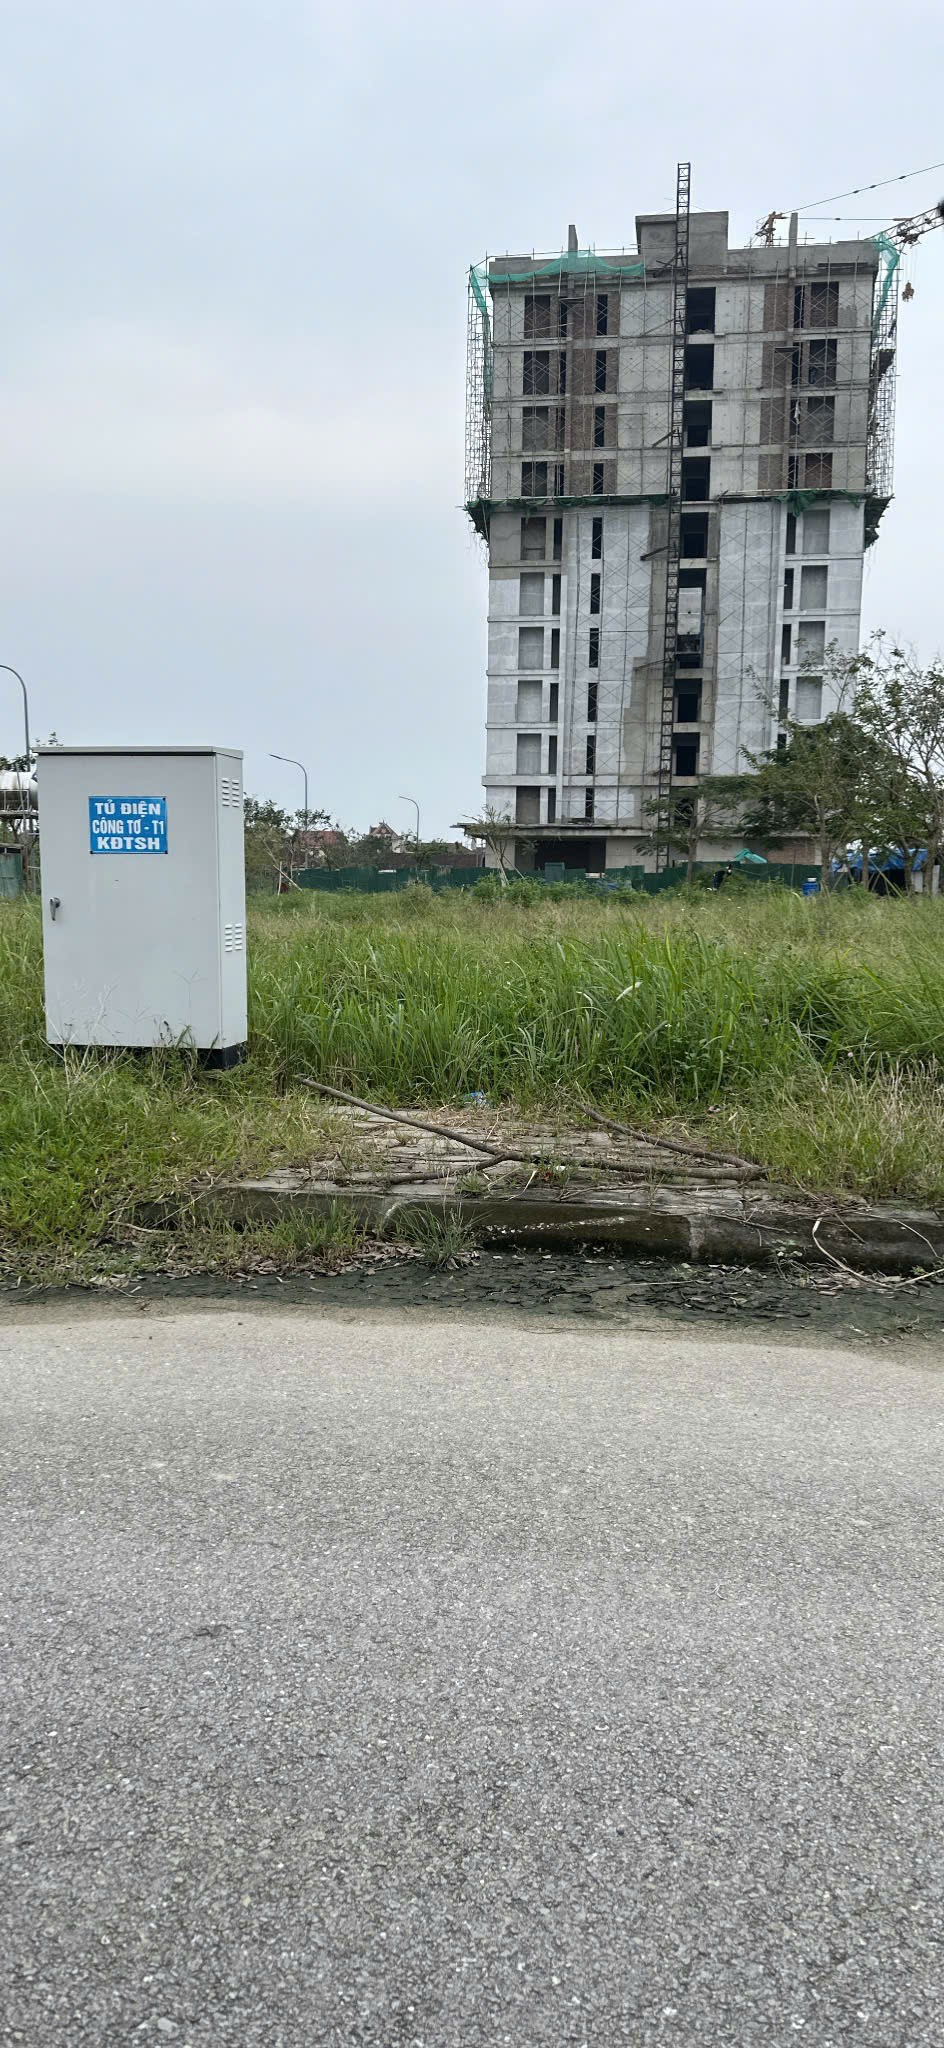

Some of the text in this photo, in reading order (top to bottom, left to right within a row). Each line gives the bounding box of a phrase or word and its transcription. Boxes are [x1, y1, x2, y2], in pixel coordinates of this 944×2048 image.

[94, 798, 161, 818] TỦ ĐIỆN
[92, 817, 124, 834] CÔNG
[152, 820, 164, 835] T1
[97, 836, 160, 850] KĐTSH
